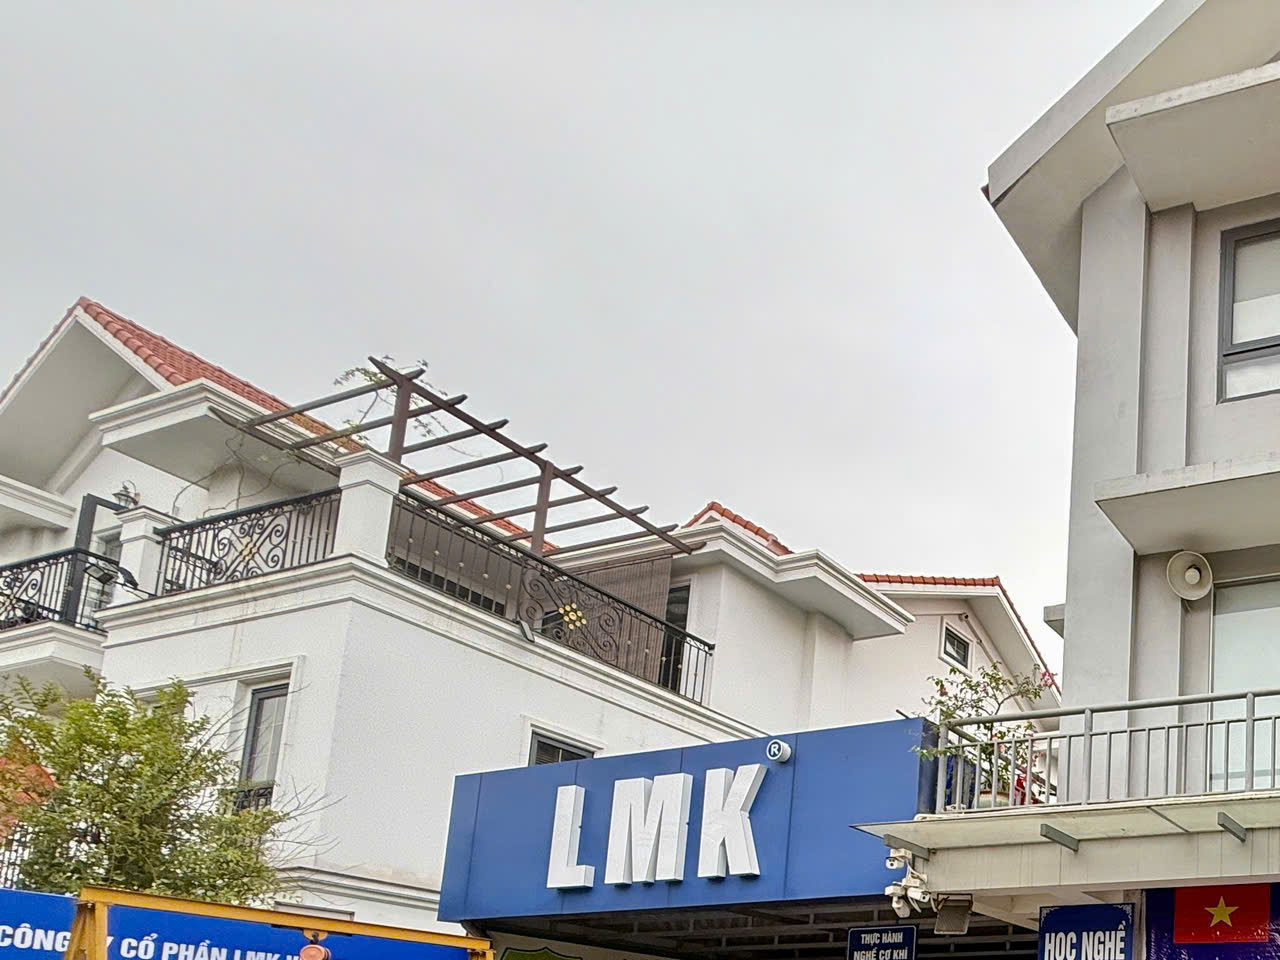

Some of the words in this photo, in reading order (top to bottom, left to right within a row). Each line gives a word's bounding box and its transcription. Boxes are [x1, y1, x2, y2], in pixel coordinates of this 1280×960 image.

[546, 763, 767, 889] LMK
[120, 933, 158, 960] CỔ
[1081, 920, 1126, 960] NGHỀ
